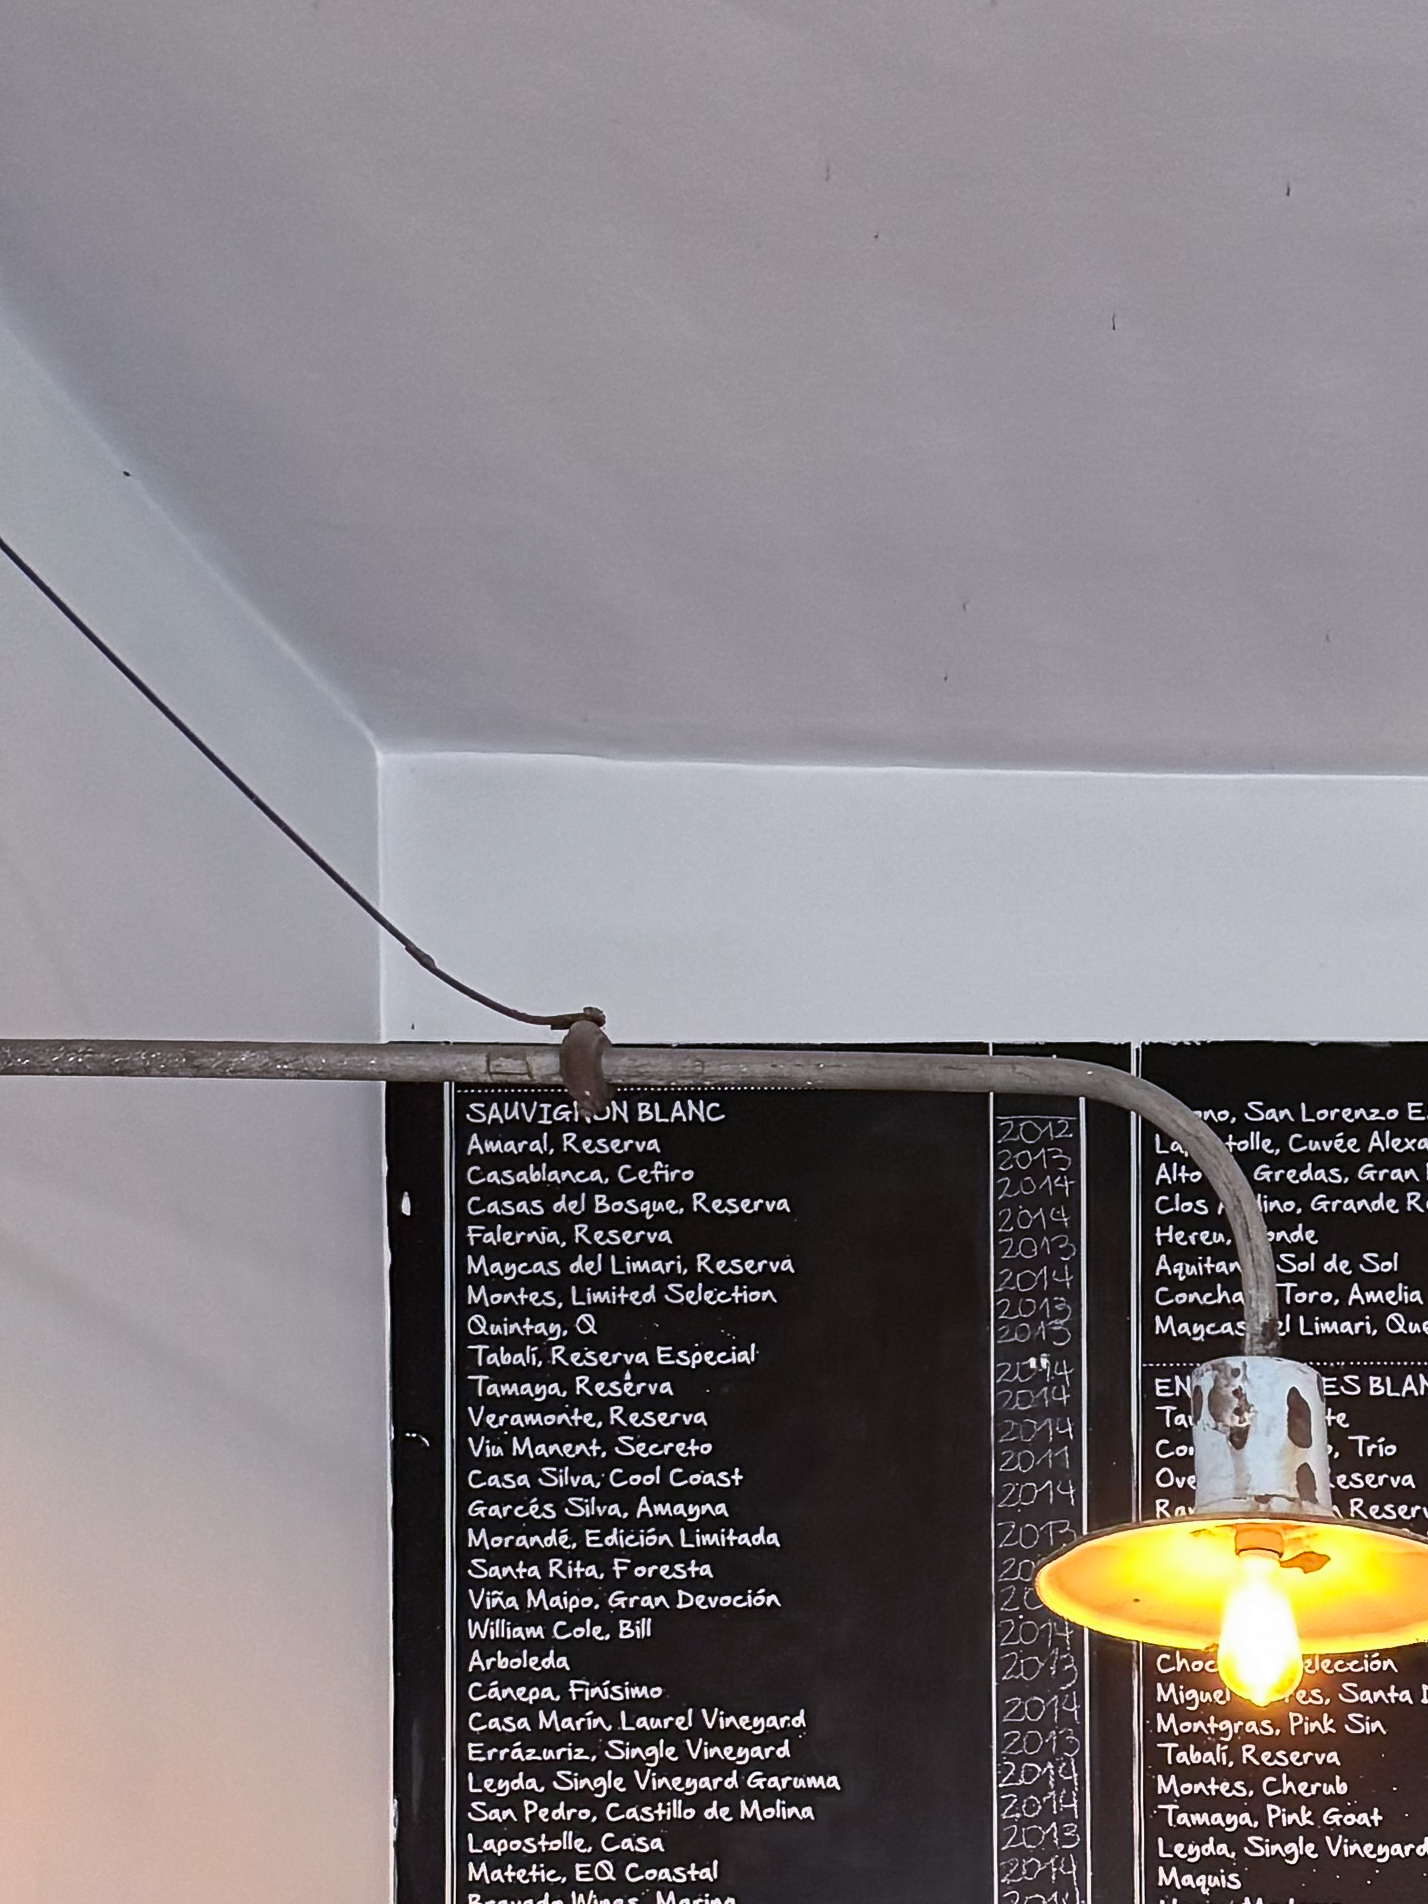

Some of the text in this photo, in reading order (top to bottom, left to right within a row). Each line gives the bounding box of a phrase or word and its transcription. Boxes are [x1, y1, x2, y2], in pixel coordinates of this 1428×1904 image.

[467, 1191, 791, 1221] Casas del Bosque, Reserva
[467, 1525, 781, 1551] Morandé, Edición Limitada
[467, 1587, 520, 1611] Viña
[607, 1590, 671, 1610] Gran
[675, 1587, 782, 1610] Devoción
[467, 1648, 571, 1673] Arboleda
[467, 1768, 842, 1799] Leyda, Single Vineyard Garuma
[1157, 1836, 1237, 1863] Leyda,
[1243, 1835, 1319, 1865] Single
[1157, 1865, 1242, 1896] Maquis
